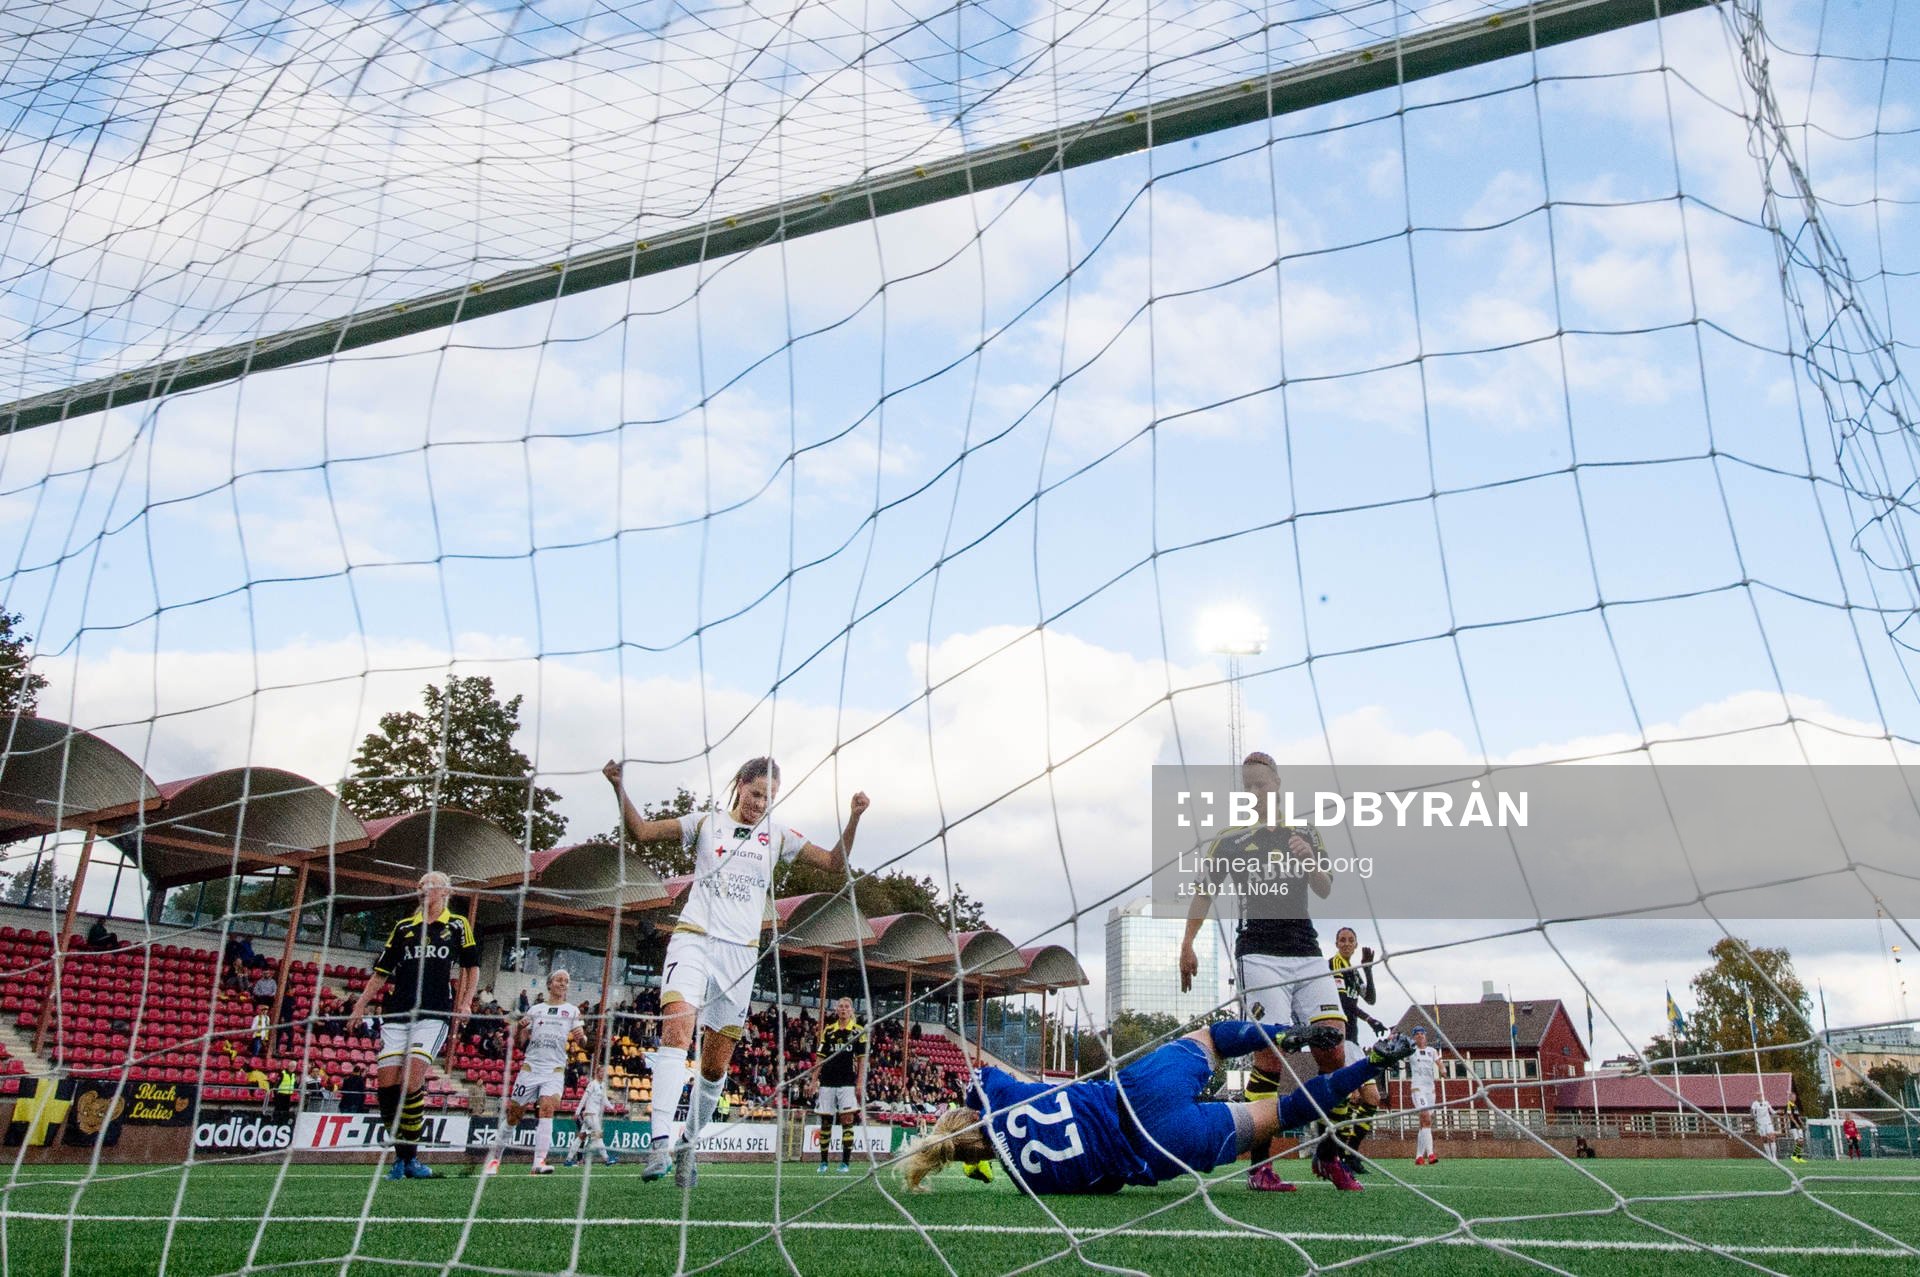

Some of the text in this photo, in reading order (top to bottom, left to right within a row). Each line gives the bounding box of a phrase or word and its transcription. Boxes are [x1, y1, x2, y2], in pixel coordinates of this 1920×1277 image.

[666, 962, 678, 984] 7
[135, 1083, 176, 1101] Black
[512, 1083, 526, 1097] 20
[129, 1101, 173, 1120] Ladies
[195, 1117, 291, 1148] adidas
[1006, 1090, 1085, 1175] 22
[746, 1138, 769, 1150] SPEL
